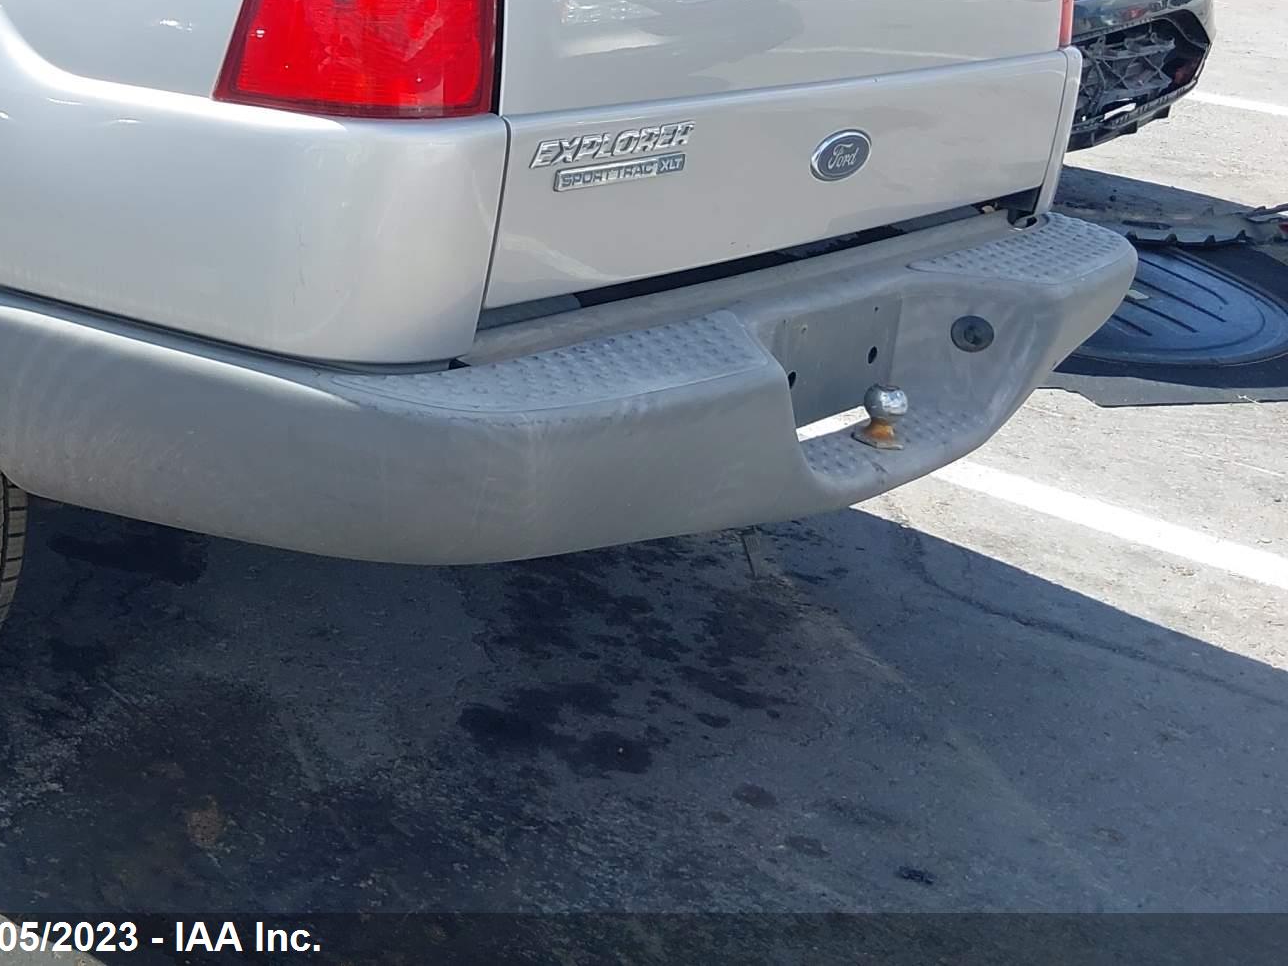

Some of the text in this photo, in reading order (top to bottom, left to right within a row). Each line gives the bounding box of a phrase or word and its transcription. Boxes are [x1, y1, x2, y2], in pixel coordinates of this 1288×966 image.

[529, 120, 696, 169] EXPLORER
[827, 142, 860, 170] Ford
[561, 157, 683, 187] SPORT TRAC XLT
